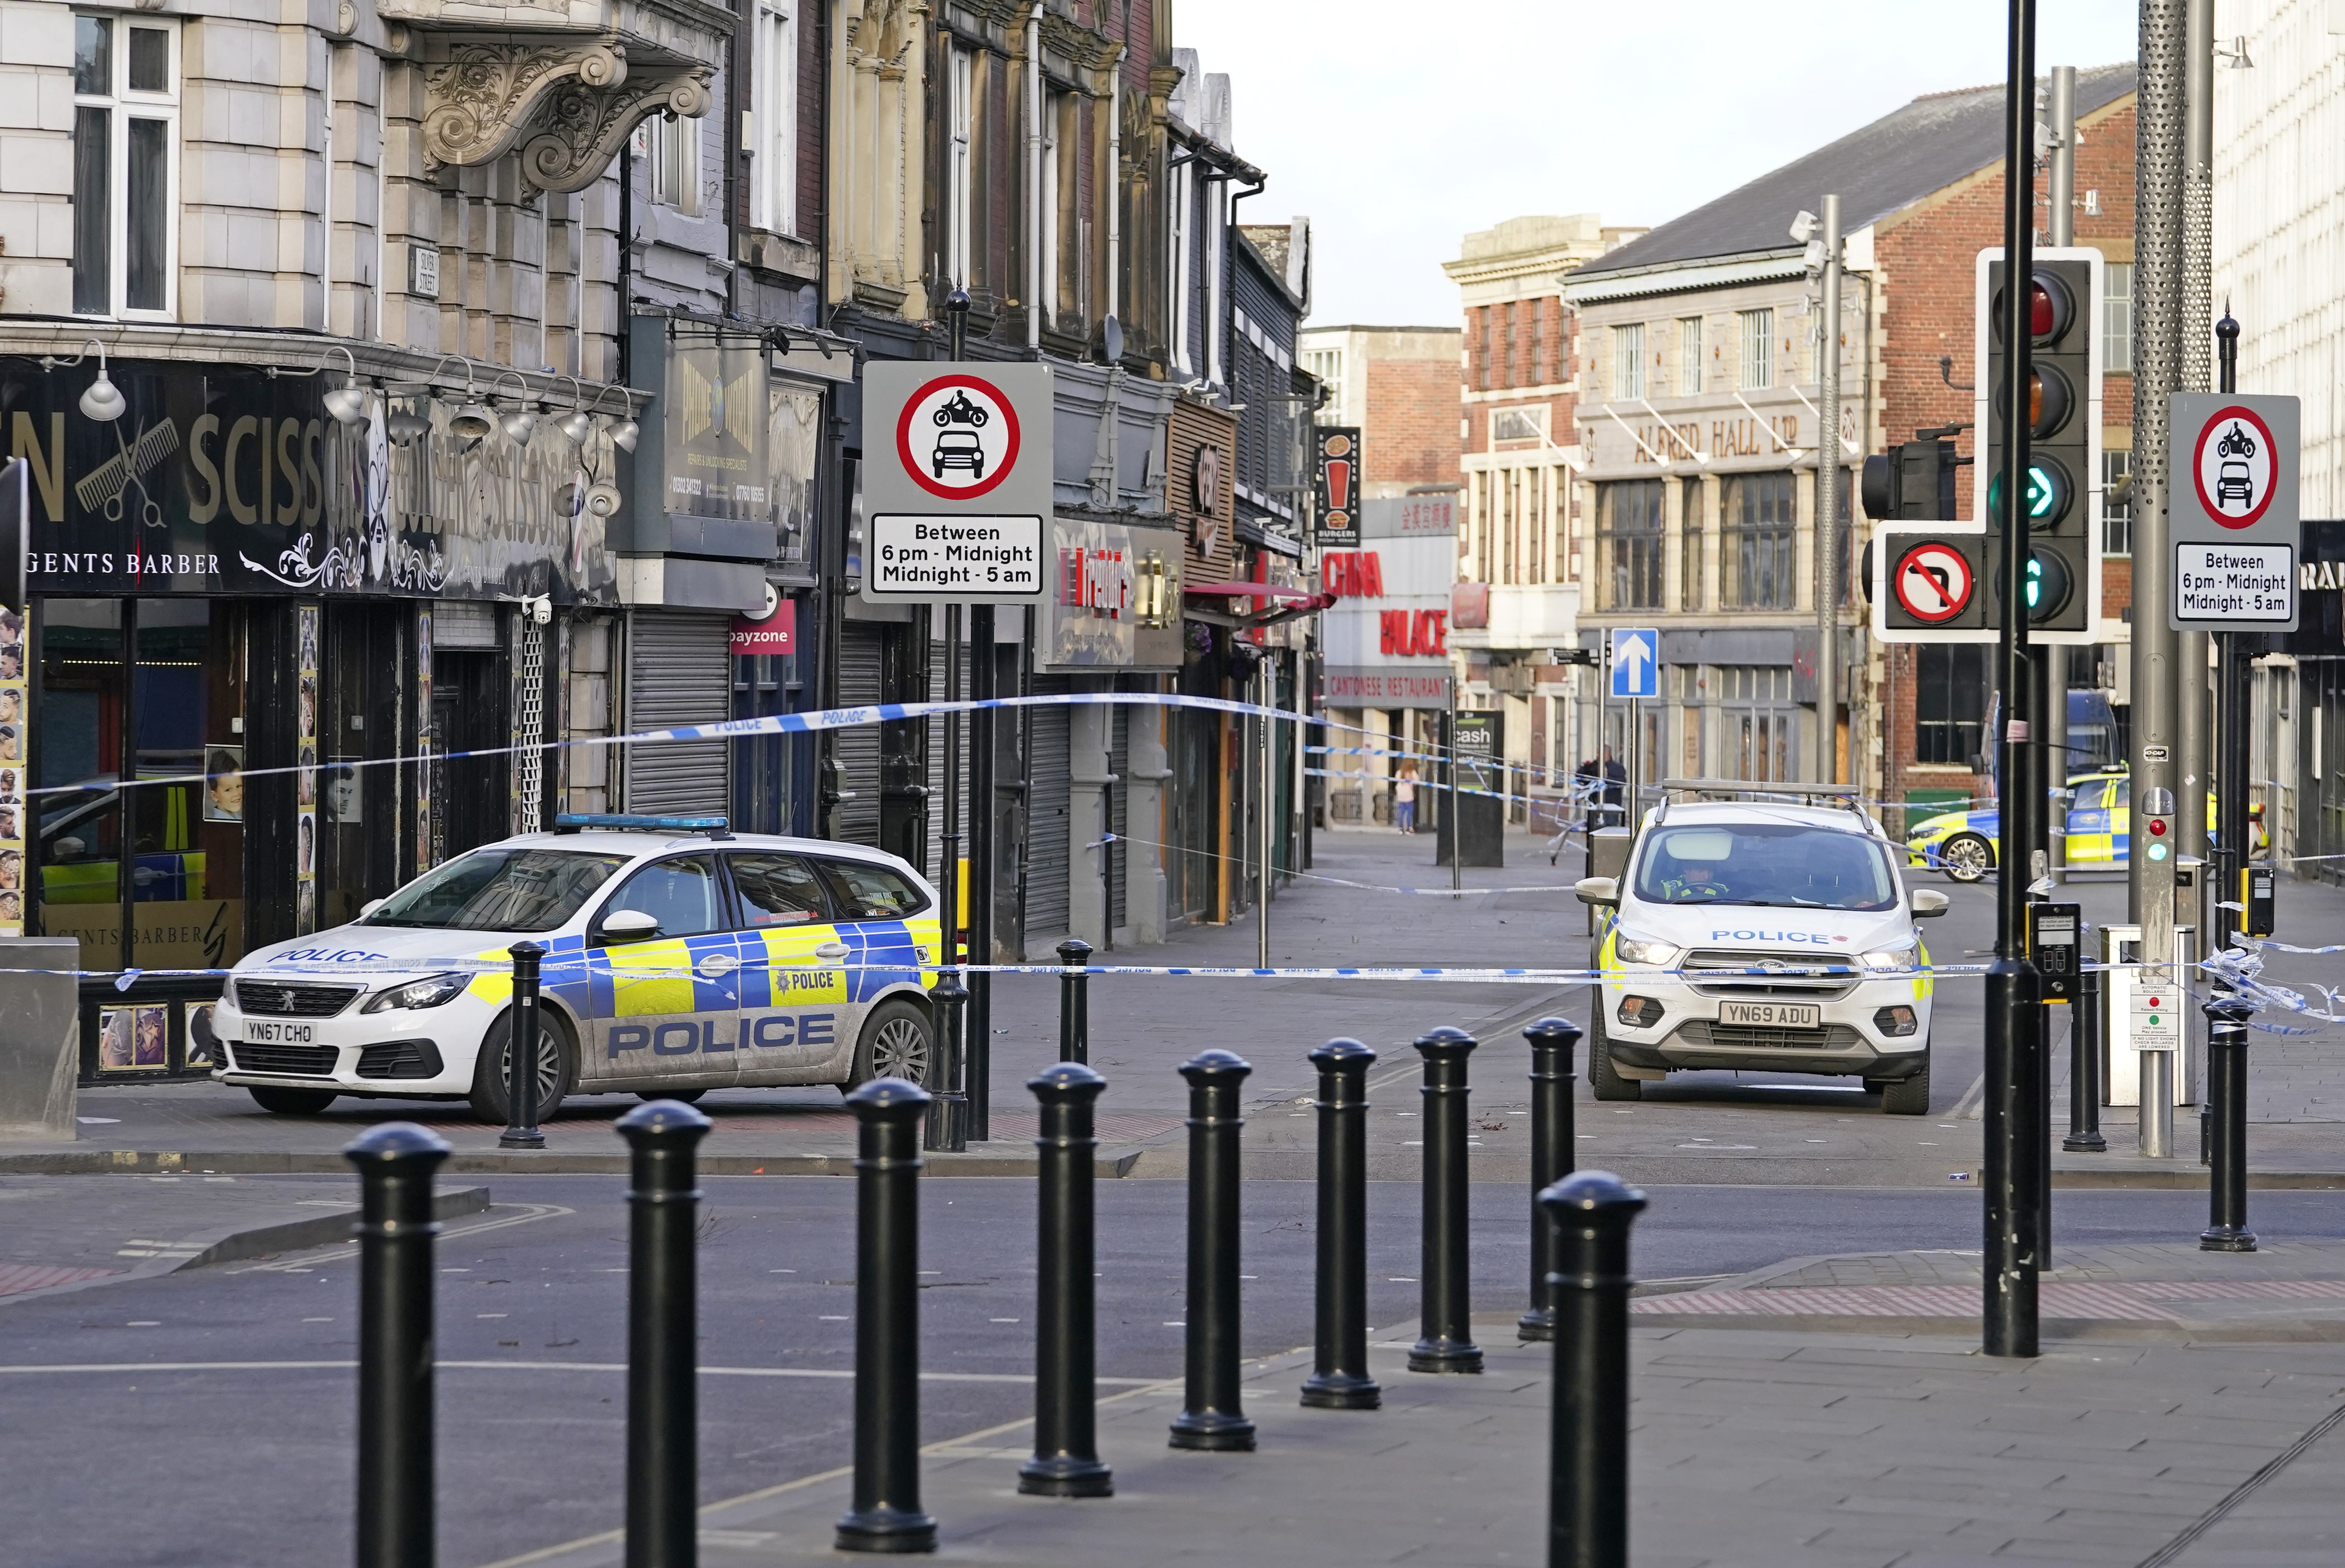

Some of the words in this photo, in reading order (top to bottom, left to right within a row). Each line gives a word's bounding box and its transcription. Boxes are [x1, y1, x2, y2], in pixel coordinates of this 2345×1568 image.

[421, 252, 435, 272] SILVER
[420, 273, 435, 292] STREET
[1635, 423, 1701, 463] ALFRED
[1713, 419, 1760, 458] HALL
[0, 411, 65, 522] N
[688, 453, 702, 466] REPAIRS
[726, 458, 747, 471] SPECIALISTS
[673, 476, 685, 493] 01302
[736, 485, 750, 501] 07760
[915, 524, 999, 540] Between
[1318, 530, 1356, 538] BURGERS
[26, 553, 113, 574] GENTS
[127, 553, 219, 574] BARBER
[882, 546, 892, 561] 6
[899, 549, 928, 563] pm
[946, 545, 1032, 564] Midnight
[2206, 553, 2264, 569] Between
[883, 566, 969, 584] Midnight
[987, 567, 998, 582] 5
[1003, 570, 1031, 582] am
[1323, 551, 1384, 597] CHINA
[2194, 578, 2214, 592] pm
[2227, 574, 2286, 592] Midnight
[2184, 594, 2243, 612] Midnight
[2265, 598, 2284, 610] am
[731, 632, 788, 646] payzone
[1381, 609, 1448, 656] PALACE
[1331, 676, 1382, 697] CANTONESE
[1387, 676, 1445, 697] RESTAURANT
[822, 710, 866, 724] POLICE
[133, 926, 202, 945] BARBER
[1712, 930, 1829, 945] POLICE
[268, 948, 389, 962] POLICE
[793, 972, 833, 989] POLICE
[1729, 1005, 1772, 1023] YN69
[1779, 1006, 1812, 1024] ADU
[249, 1023, 282, 1041] YN67
[286, 1025, 311, 1043] CHO
[607, 1014, 835, 1059] POLICE
